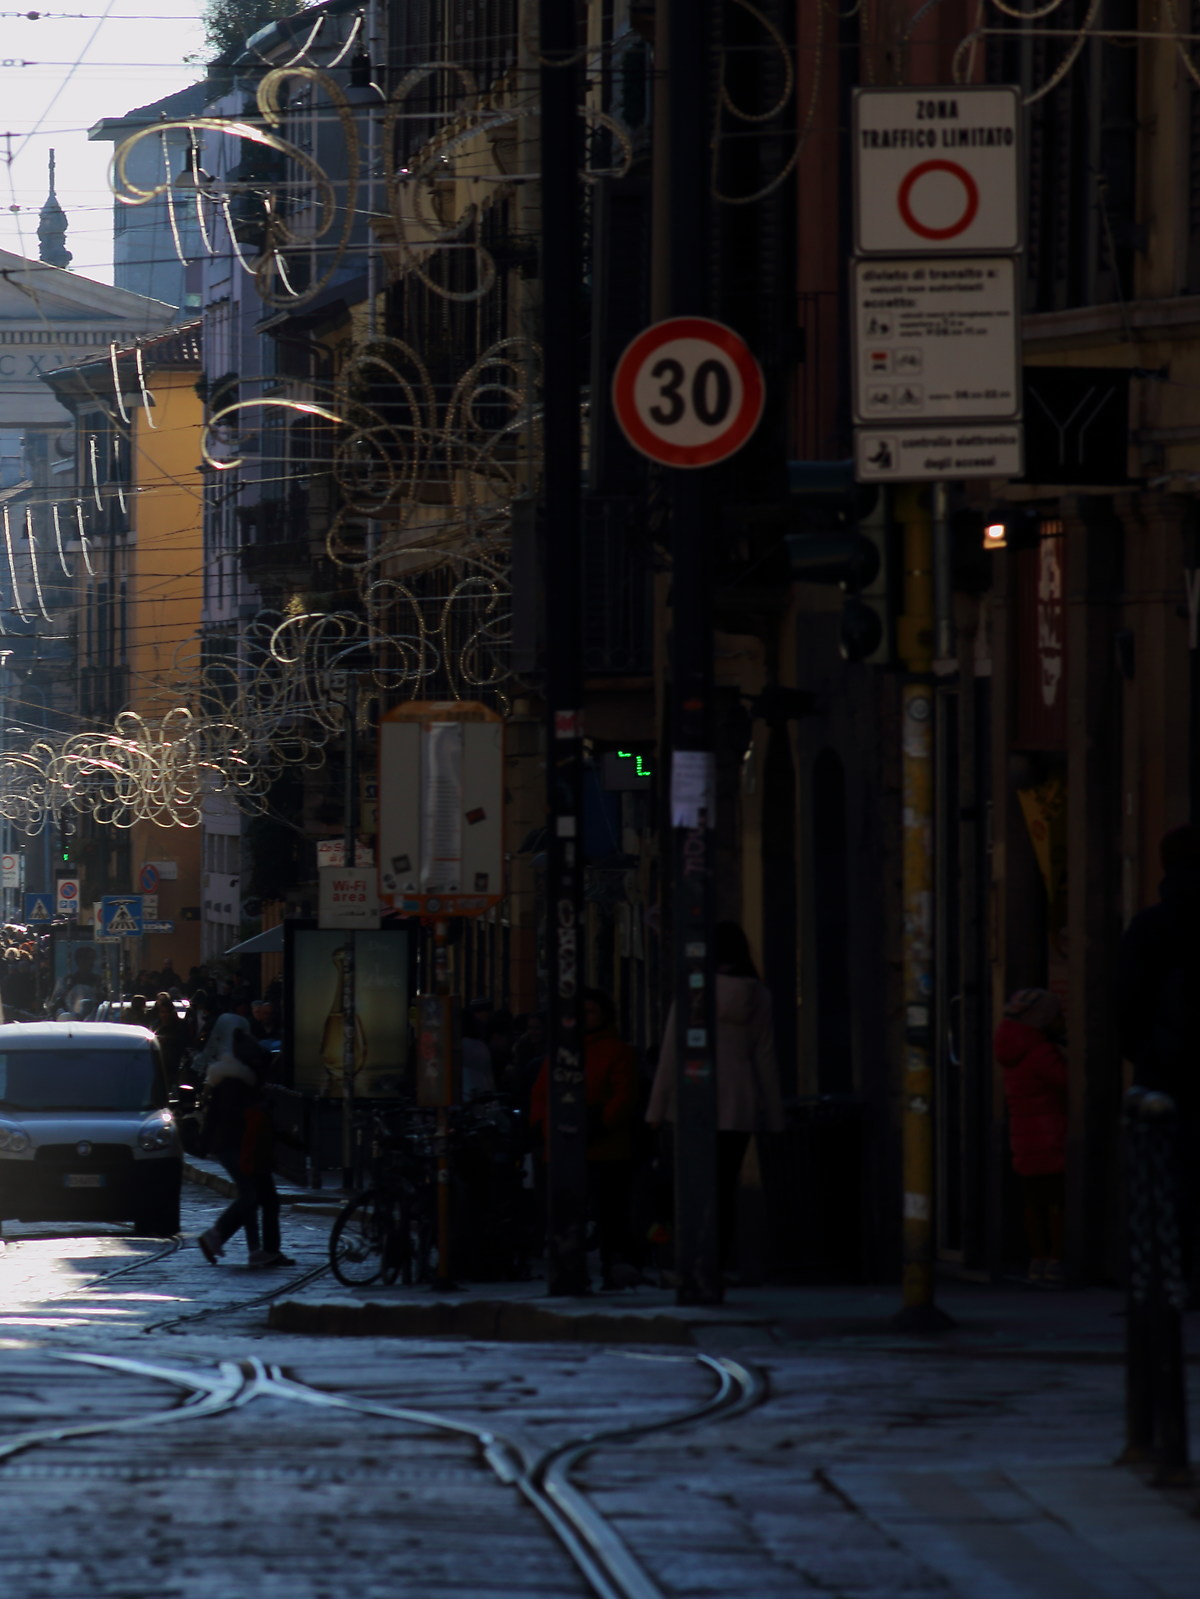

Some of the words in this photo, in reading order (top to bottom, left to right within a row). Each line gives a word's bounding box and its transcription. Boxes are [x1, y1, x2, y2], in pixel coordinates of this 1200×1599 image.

[916, 100, 959, 119] ZONA
[862, 129, 937, 148] TRAFFICO
[942, 127, 1014, 147] LIMITATO
[649, 358, 732, 426] 30
[332, 880, 367, 891] Wi-Fi
[332, 894, 367, 902] area
